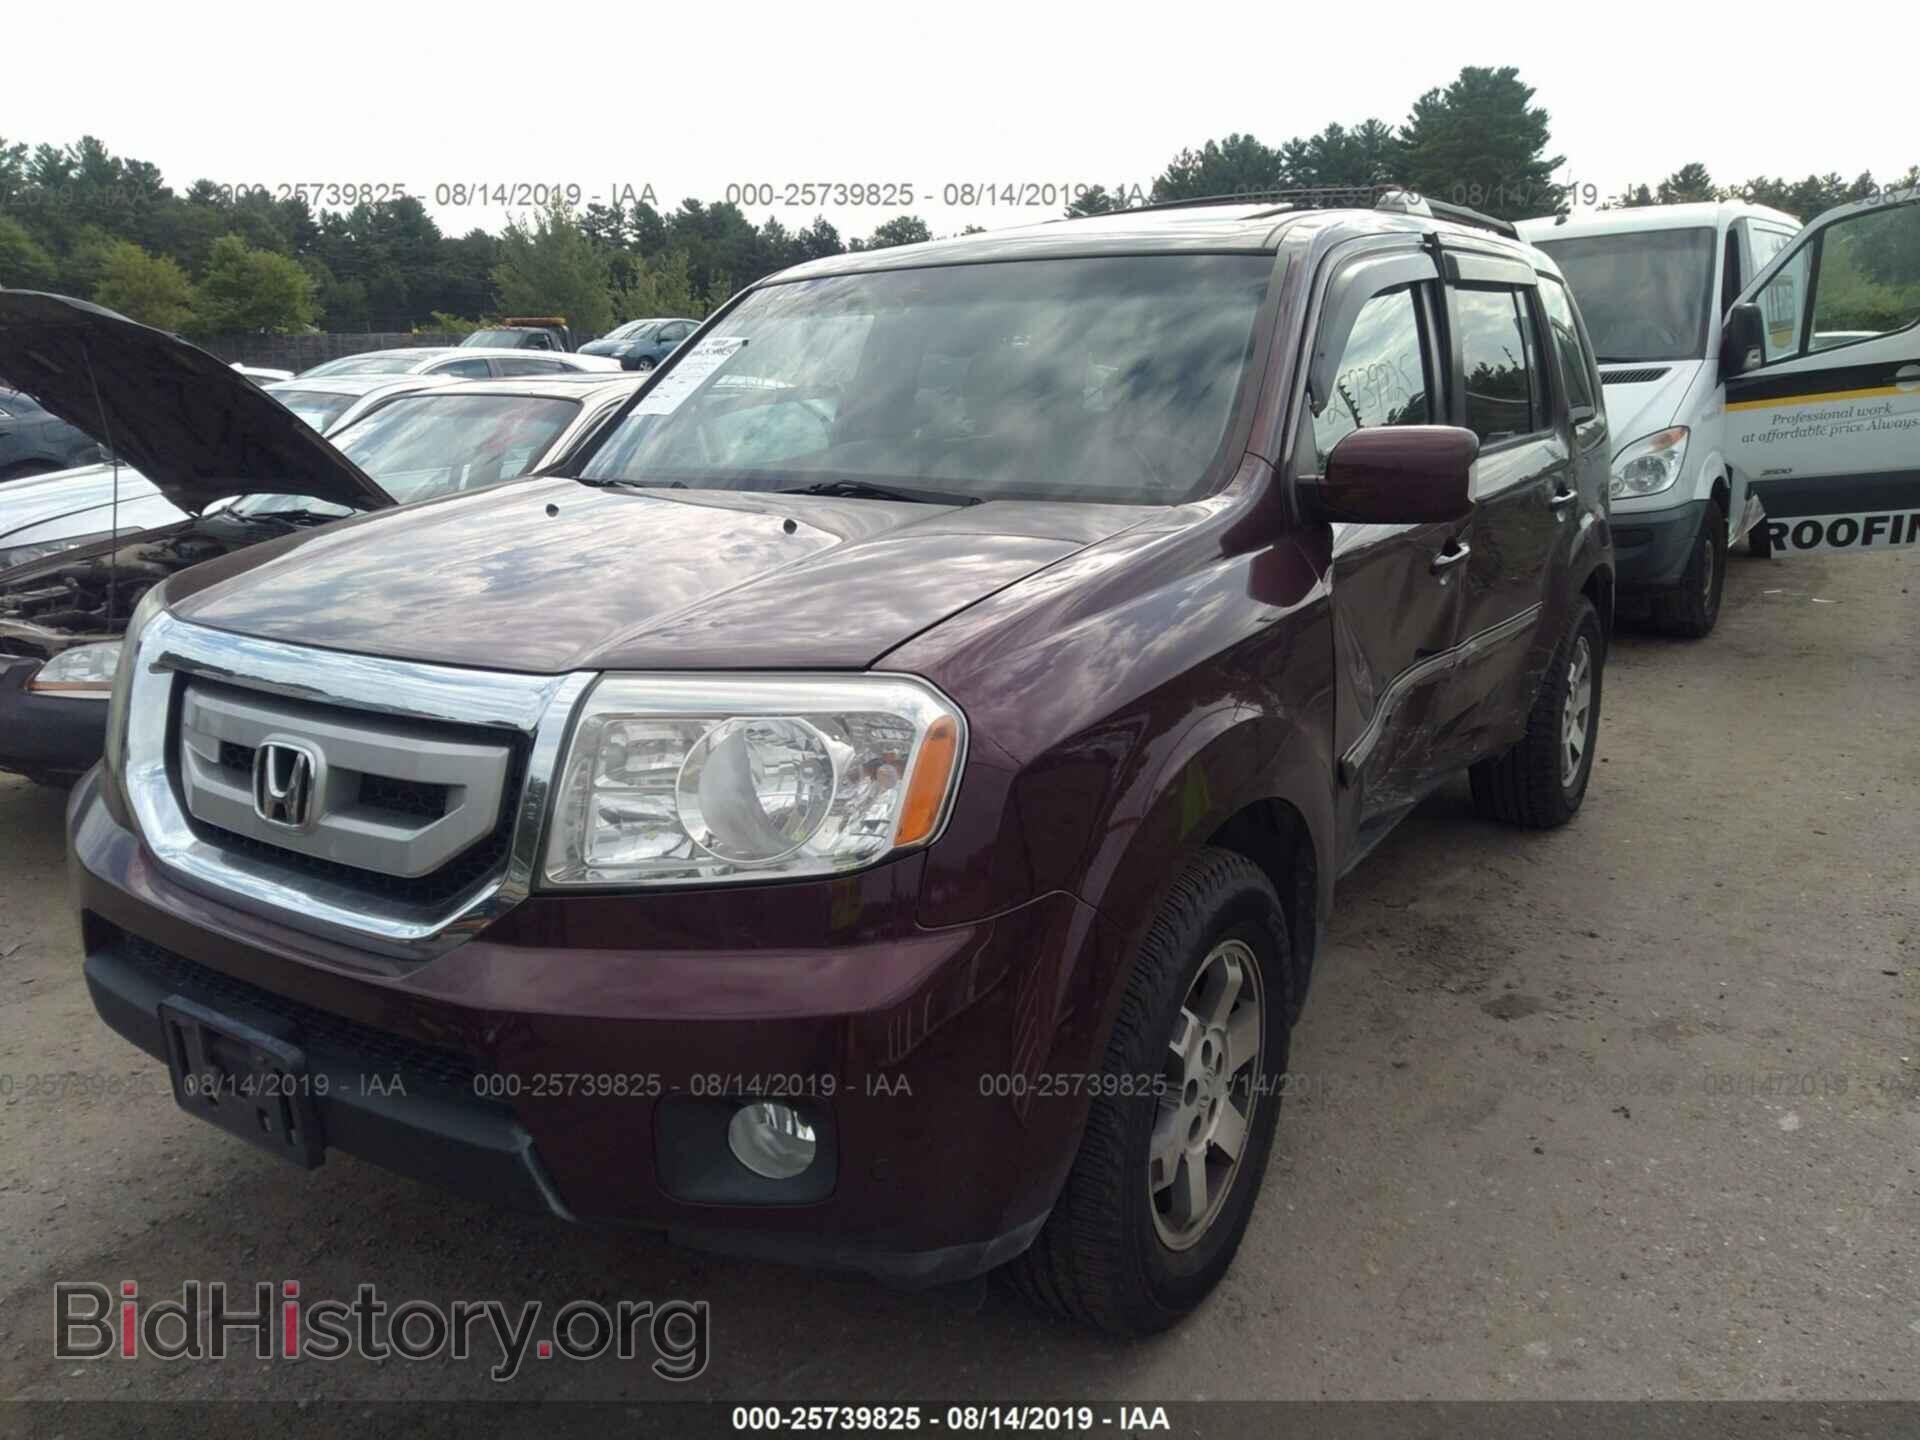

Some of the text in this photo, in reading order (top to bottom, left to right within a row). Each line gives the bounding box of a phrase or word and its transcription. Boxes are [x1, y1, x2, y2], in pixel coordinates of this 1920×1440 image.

[1772, 402, 1893, 426] Professional work
[1741, 432, 1756, 443] at
[1758, 423, 1827, 443] affordable
[1829, 420, 1863, 437] price
